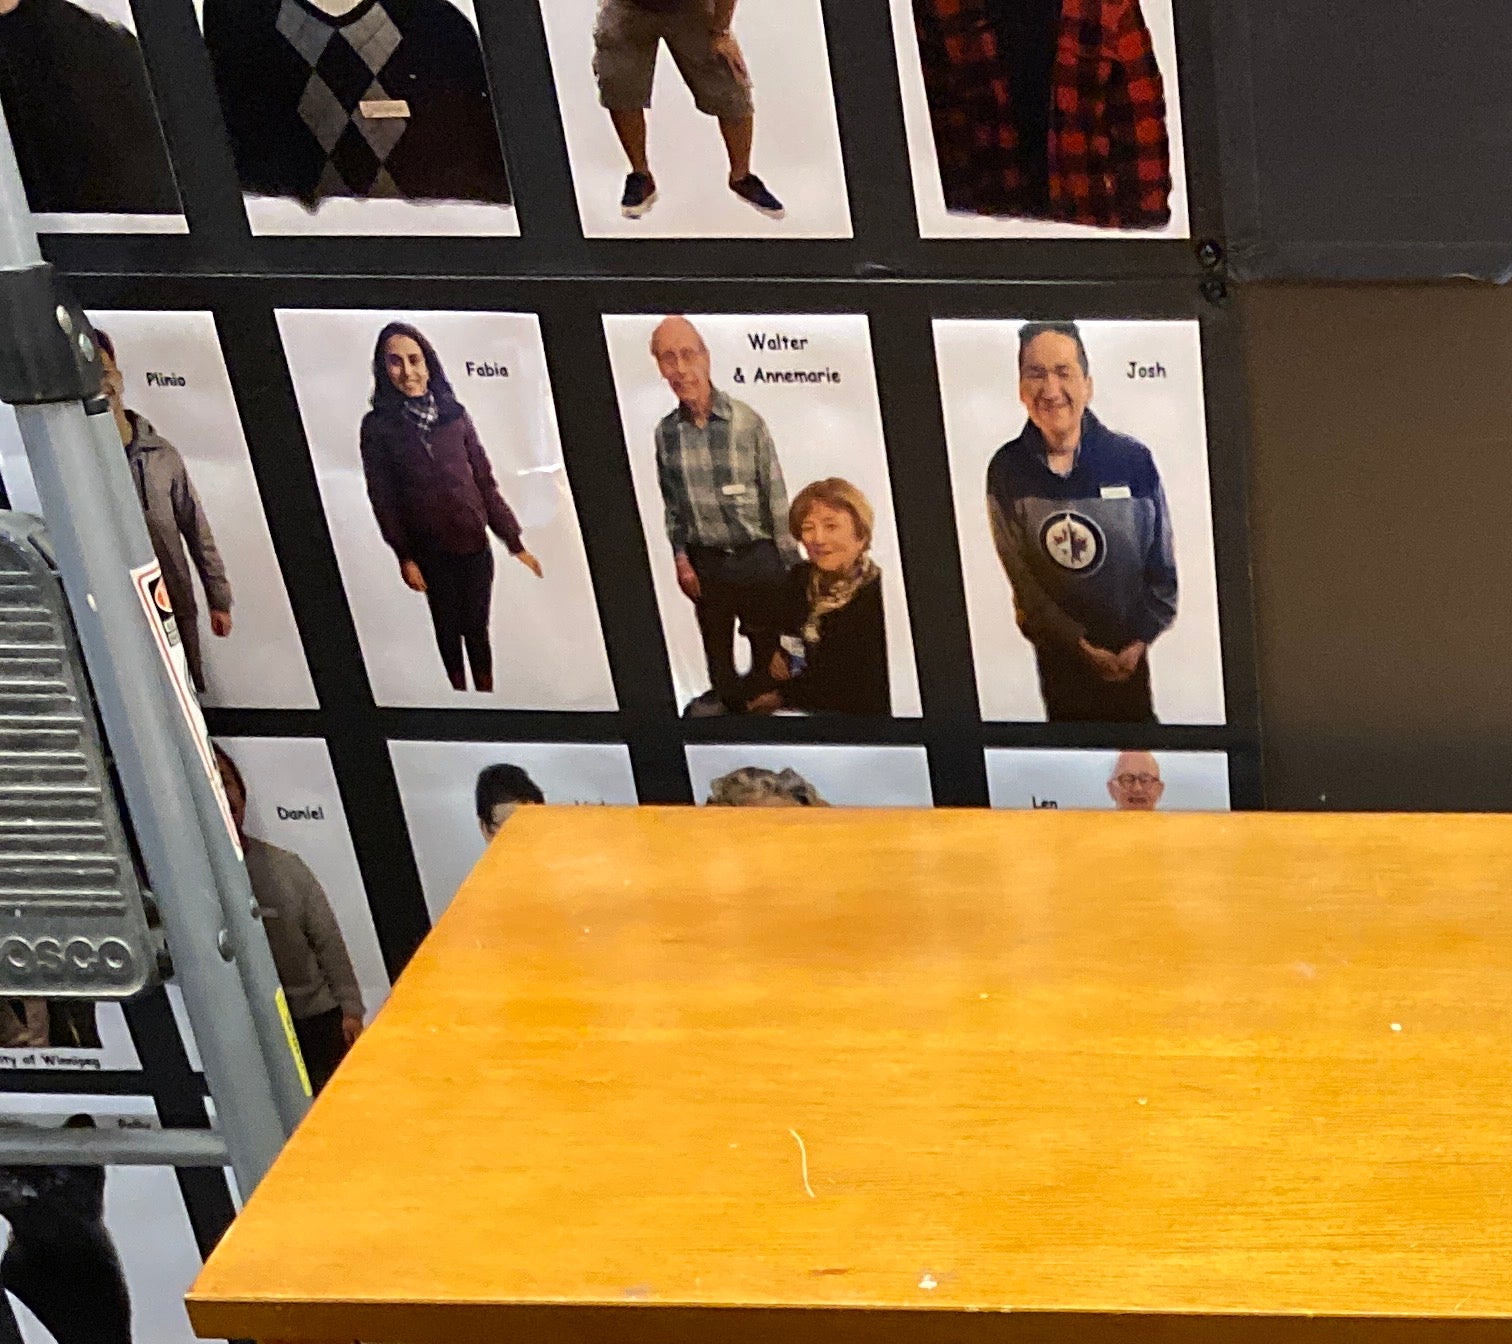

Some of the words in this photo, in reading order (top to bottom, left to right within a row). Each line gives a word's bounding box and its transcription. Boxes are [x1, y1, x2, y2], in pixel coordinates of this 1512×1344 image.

[747, 333, 808, 350] Walter
[465, 361, 509, 377] Fabia
[733, 367, 745, 384] &
[753, 366, 841, 383] Annemarie
[1127, 361, 1167, 379] Josh
[146, 371, 186, 387] Plinio
[276, 805, 325, 820] Daniel
[40, 1055, 101, 1070] Winnipeg
